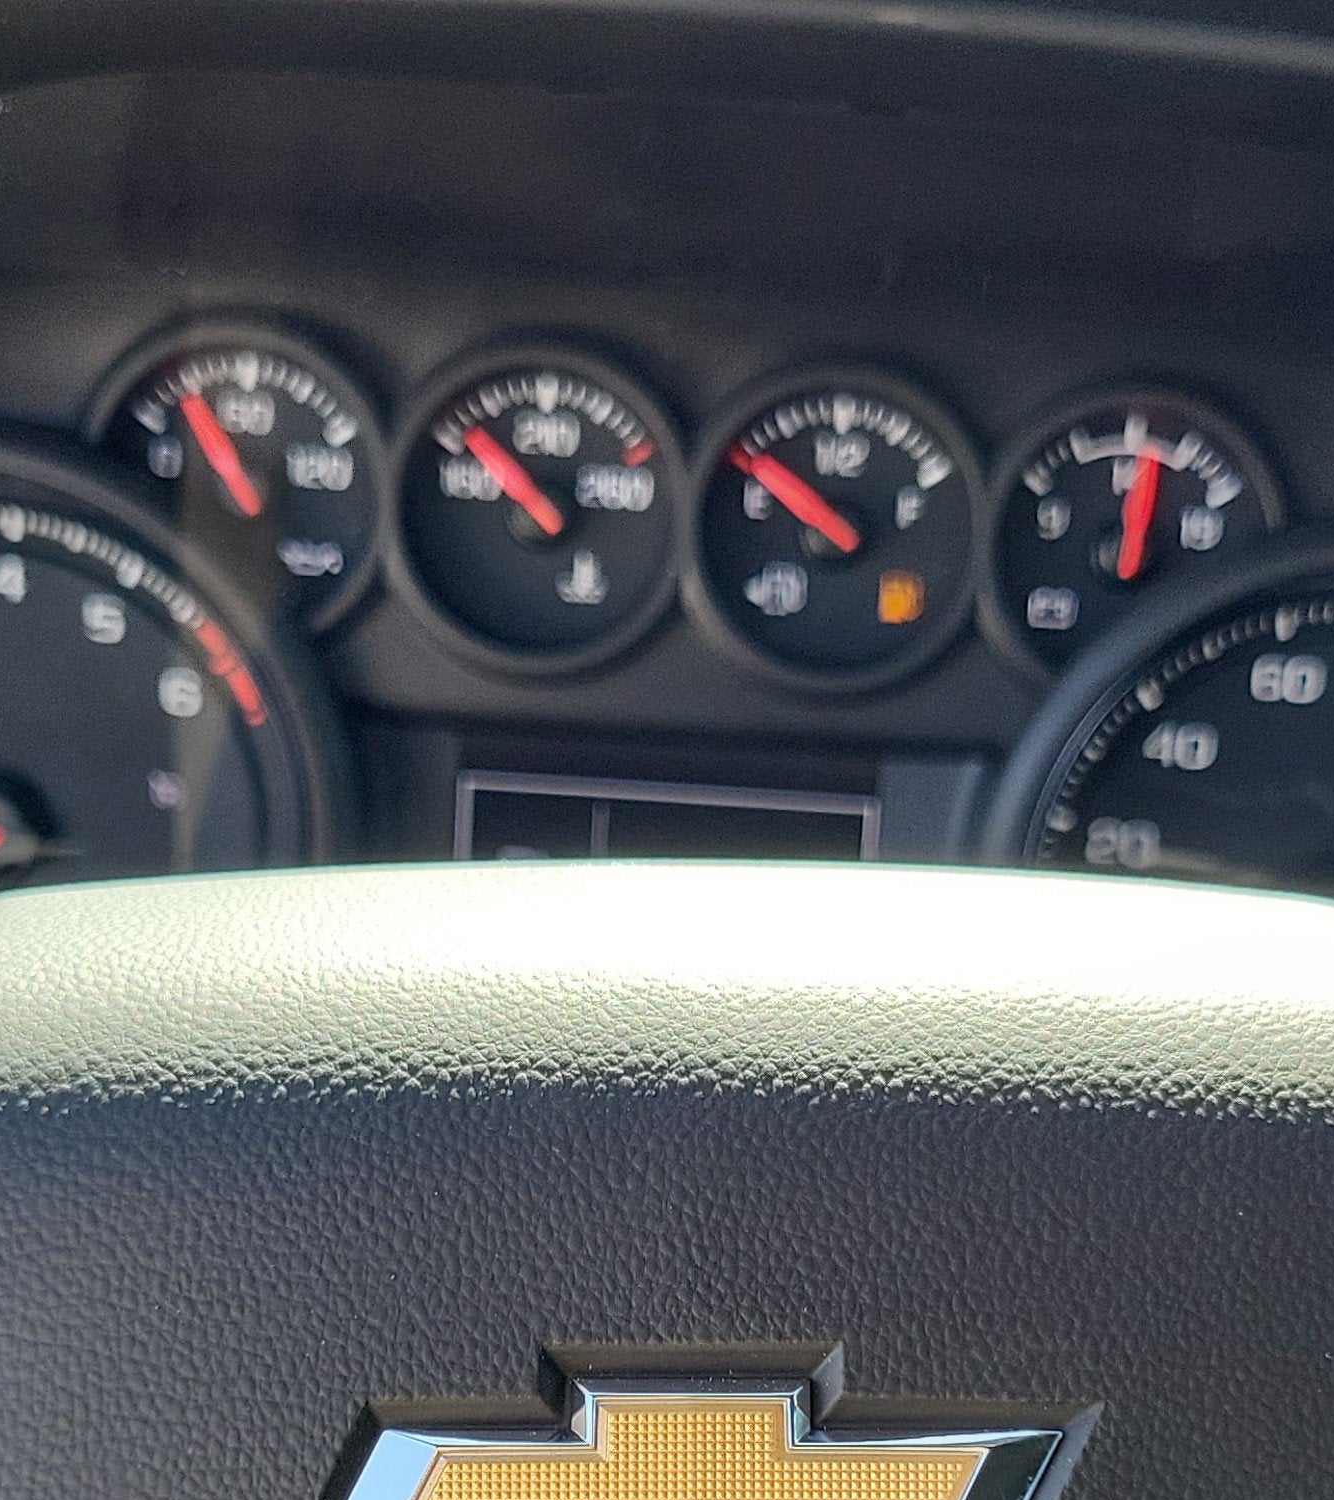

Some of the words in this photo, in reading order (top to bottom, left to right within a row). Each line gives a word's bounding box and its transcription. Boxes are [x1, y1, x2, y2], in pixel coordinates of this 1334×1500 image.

[81, 592, 128, 644] 5
[158, 666, 203, 718] 6
[1250, 653, 1328, 705] 60
[1141, 720, 1220, 771] 40
[1084, 815, 1161, 869] 20
